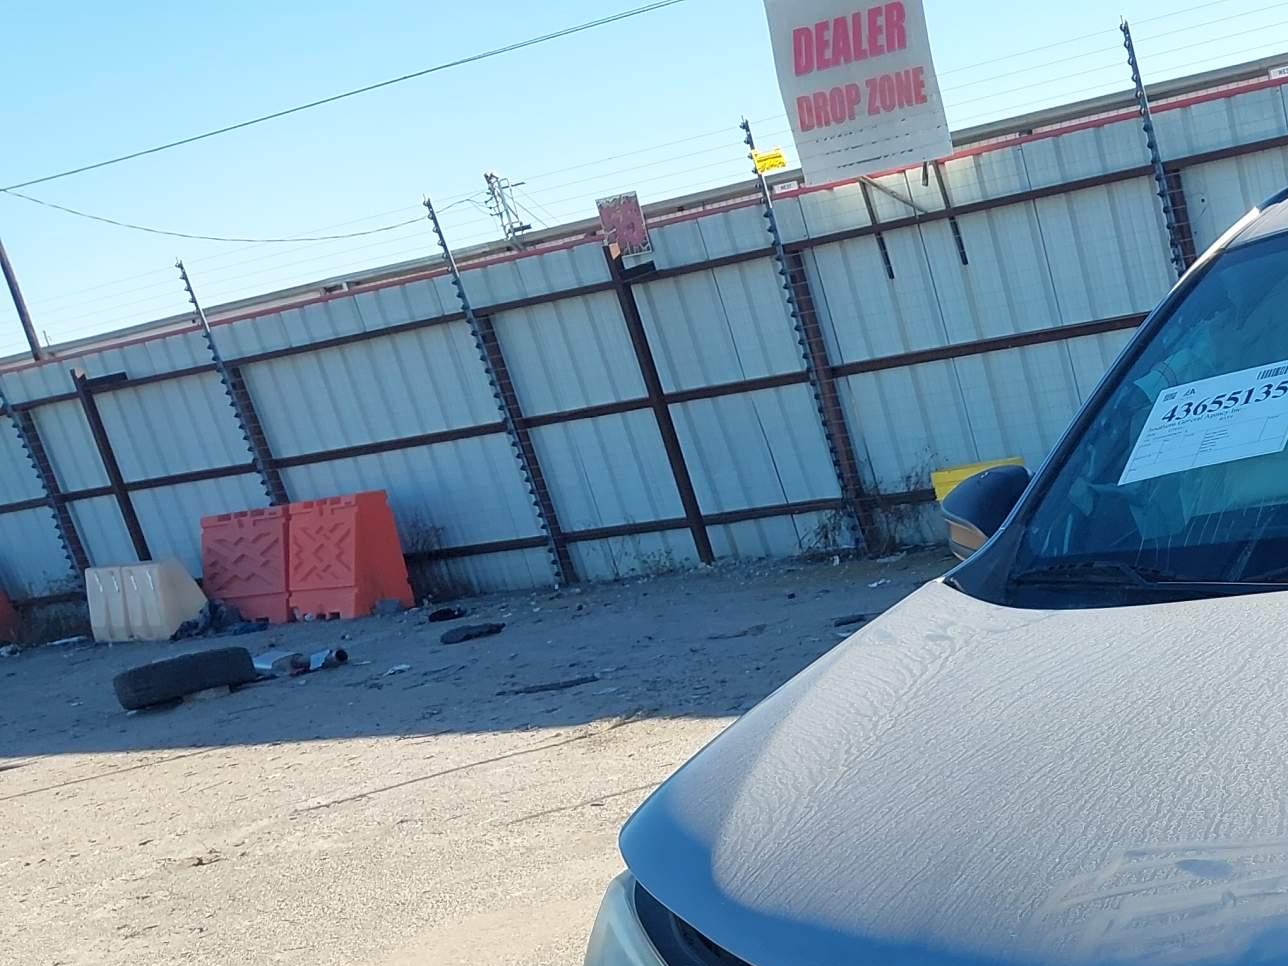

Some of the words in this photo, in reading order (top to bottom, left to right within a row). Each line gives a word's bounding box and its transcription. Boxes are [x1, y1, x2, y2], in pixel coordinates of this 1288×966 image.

[792, 1, 907, 77] DEALER
[796, 83, 861, 132] DROP
[865, 66, 928, 117] ZONE
